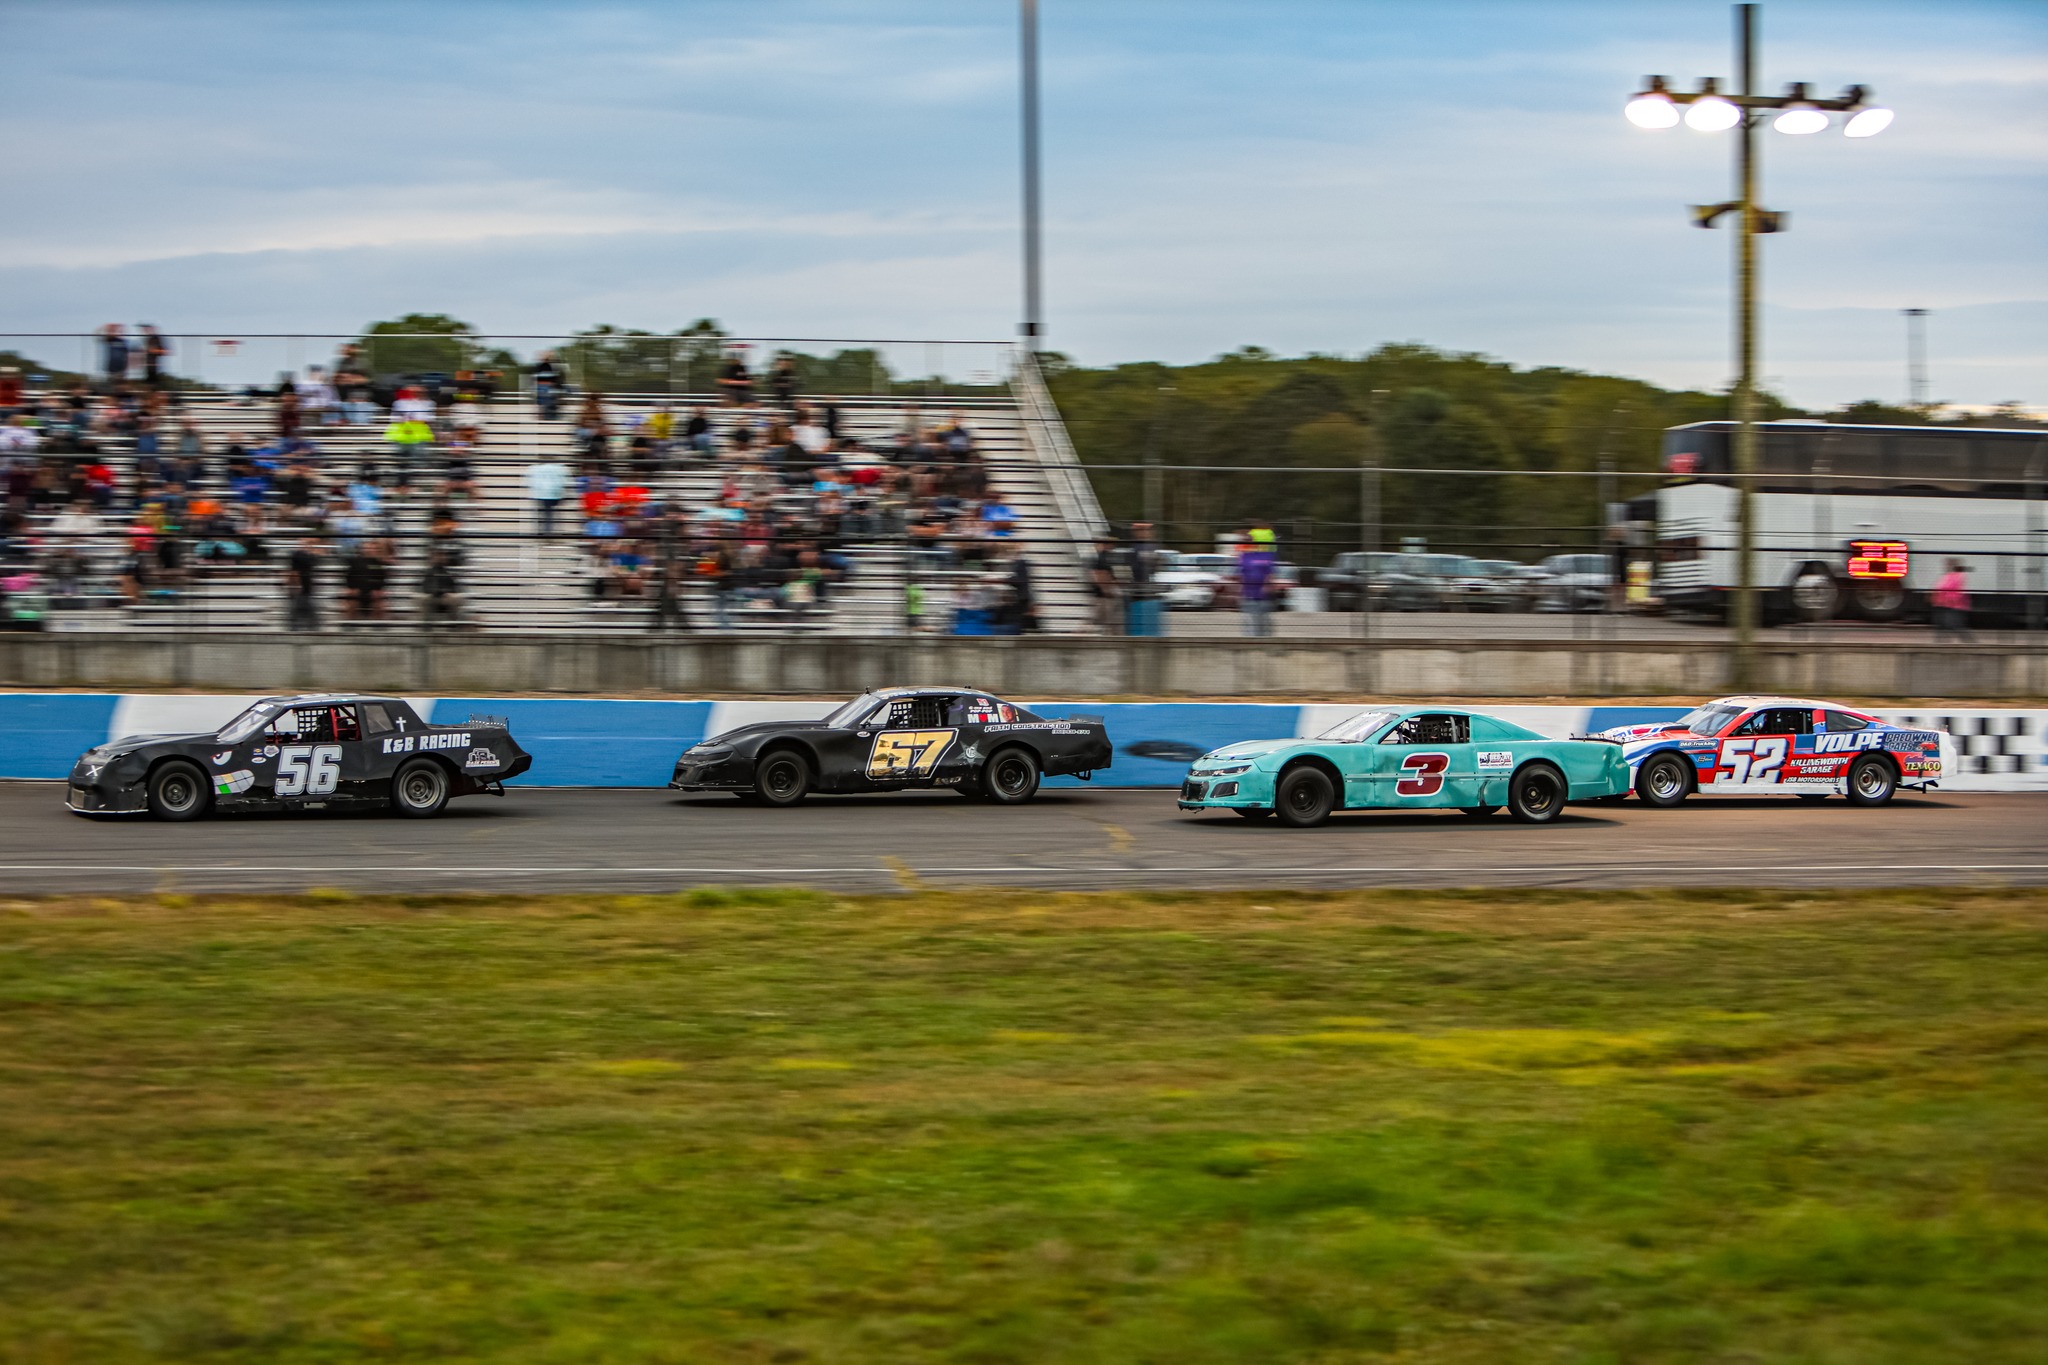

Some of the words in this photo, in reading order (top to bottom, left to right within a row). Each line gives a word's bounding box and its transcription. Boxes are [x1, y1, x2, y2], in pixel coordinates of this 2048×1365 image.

[984, 724, 1010, 733] FAITH
[383, 737, 414, 753] K&B
[419, 733, 471, 750] RACING
[1815, 732, 1884, 753] VOLPE
[1885, 732, 1939, 743] PREOWNED
[866, 728, 959, 780] 67
[1888, 742, 1914, 751] CARS
[1713, 738, 1788, 784] 52
[1790, 757, 1849, 767] KILLINGWORTH
[1905, 761, 1941, 771] TEXACO
[275, 744, 342, 795] 56
[1395, 752, 1450, 797] 3
[1800, 765, 1833, 774] GARAGE
